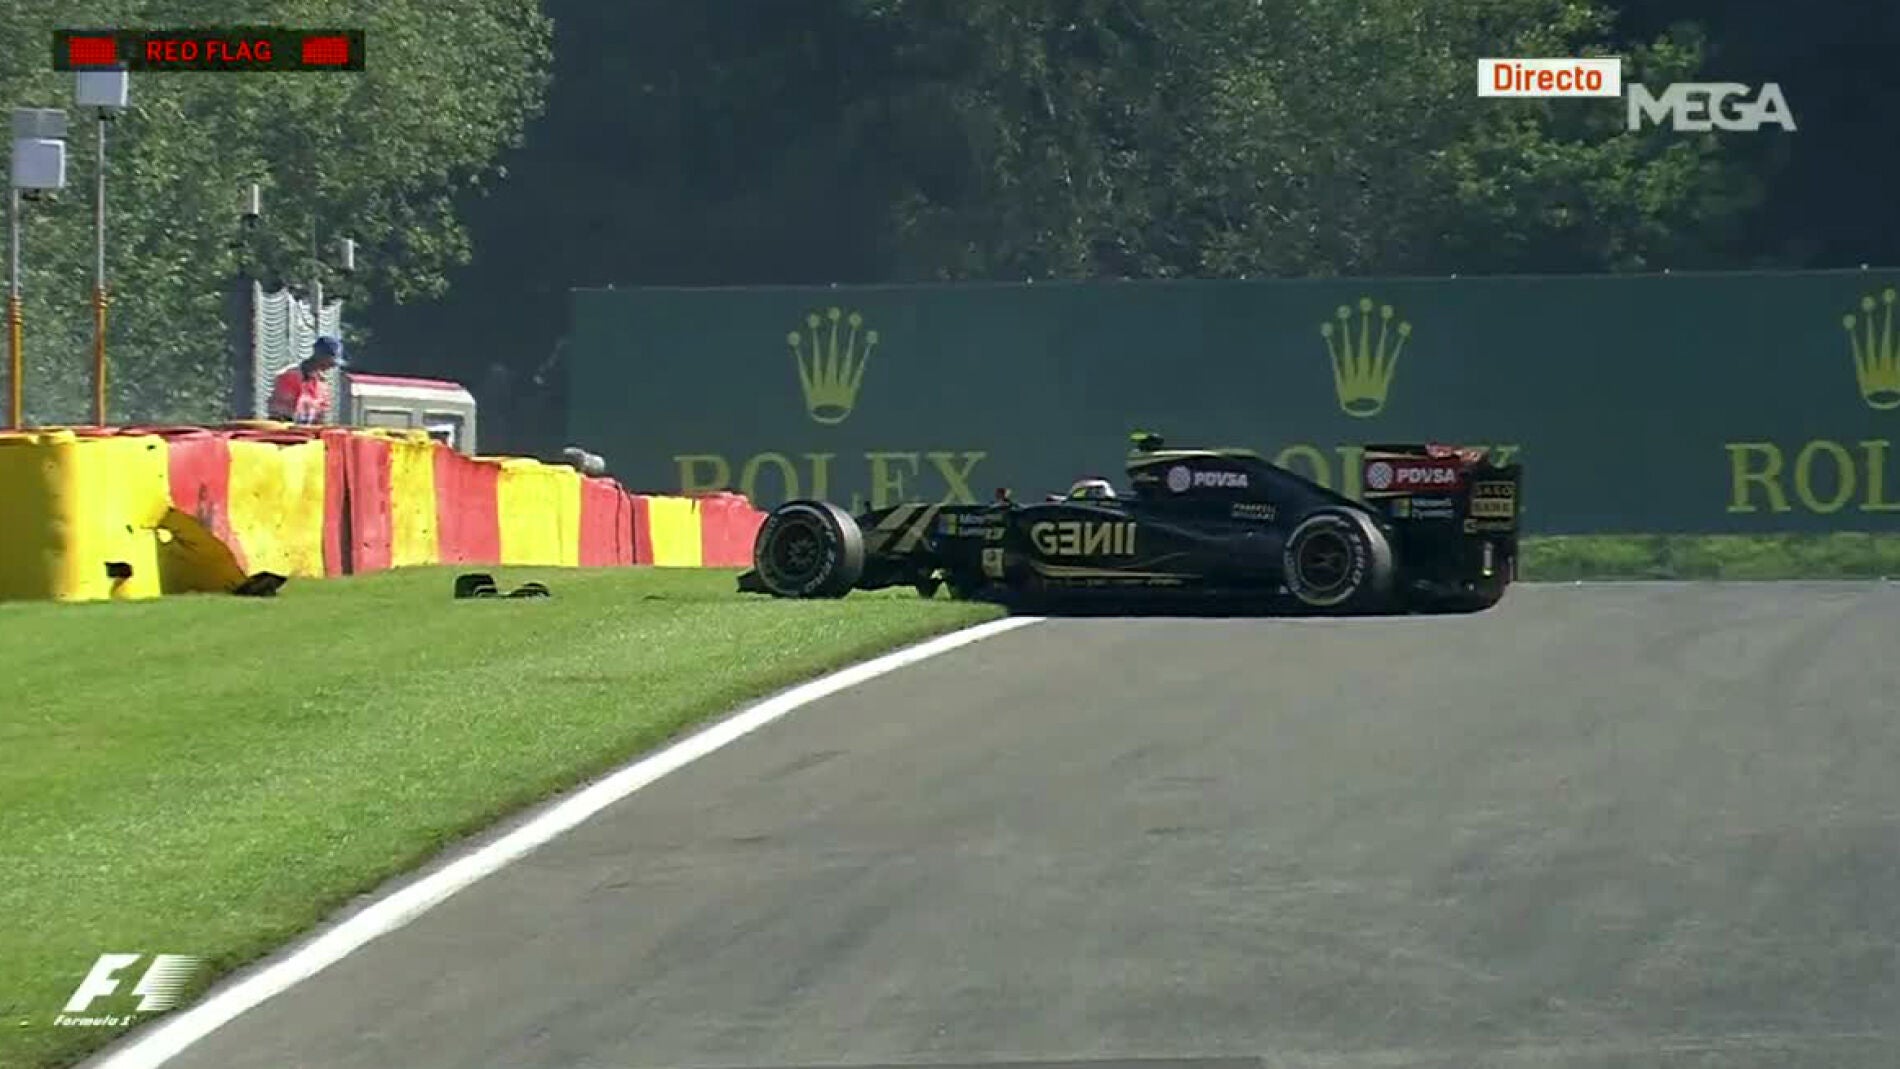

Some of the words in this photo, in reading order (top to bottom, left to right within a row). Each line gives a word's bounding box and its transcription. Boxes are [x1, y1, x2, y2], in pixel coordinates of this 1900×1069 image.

[1194, 471, 1248, 488] PDVSA
[1396, 467, 1457, 484] PDVSA
[1030, 521, 1137, 556] GENII
